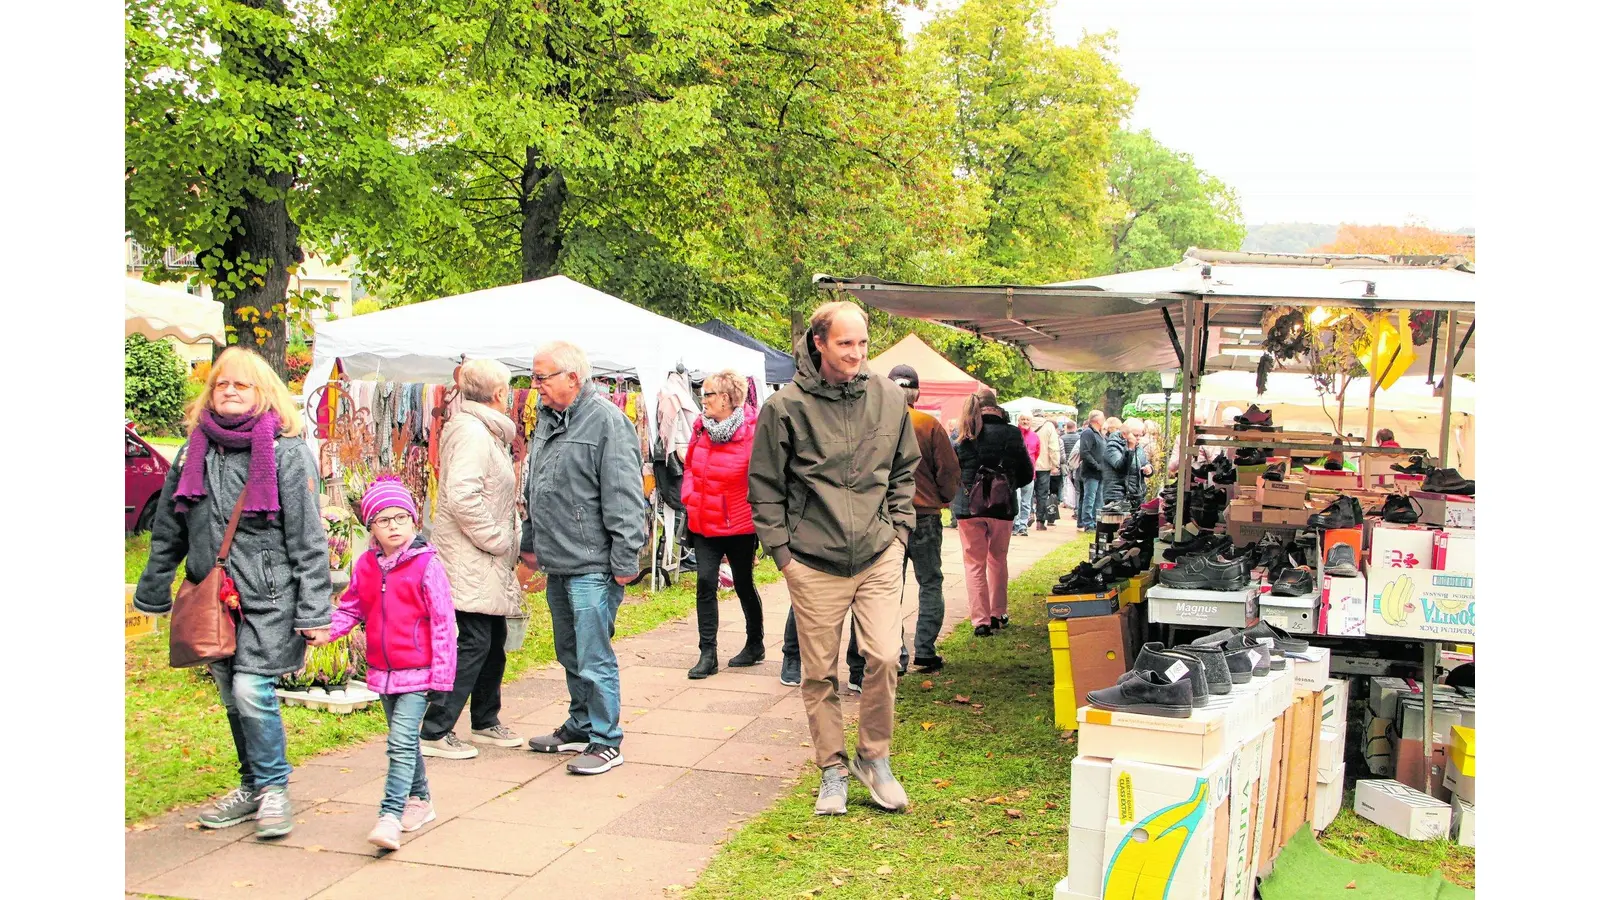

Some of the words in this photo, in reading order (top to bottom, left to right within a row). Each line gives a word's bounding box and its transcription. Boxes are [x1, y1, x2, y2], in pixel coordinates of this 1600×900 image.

[1175, 602, 1218, 614] Magnus
[1419, 598, 1475, 626] BONITA
[1419, 625, 1439, 633] PACK
